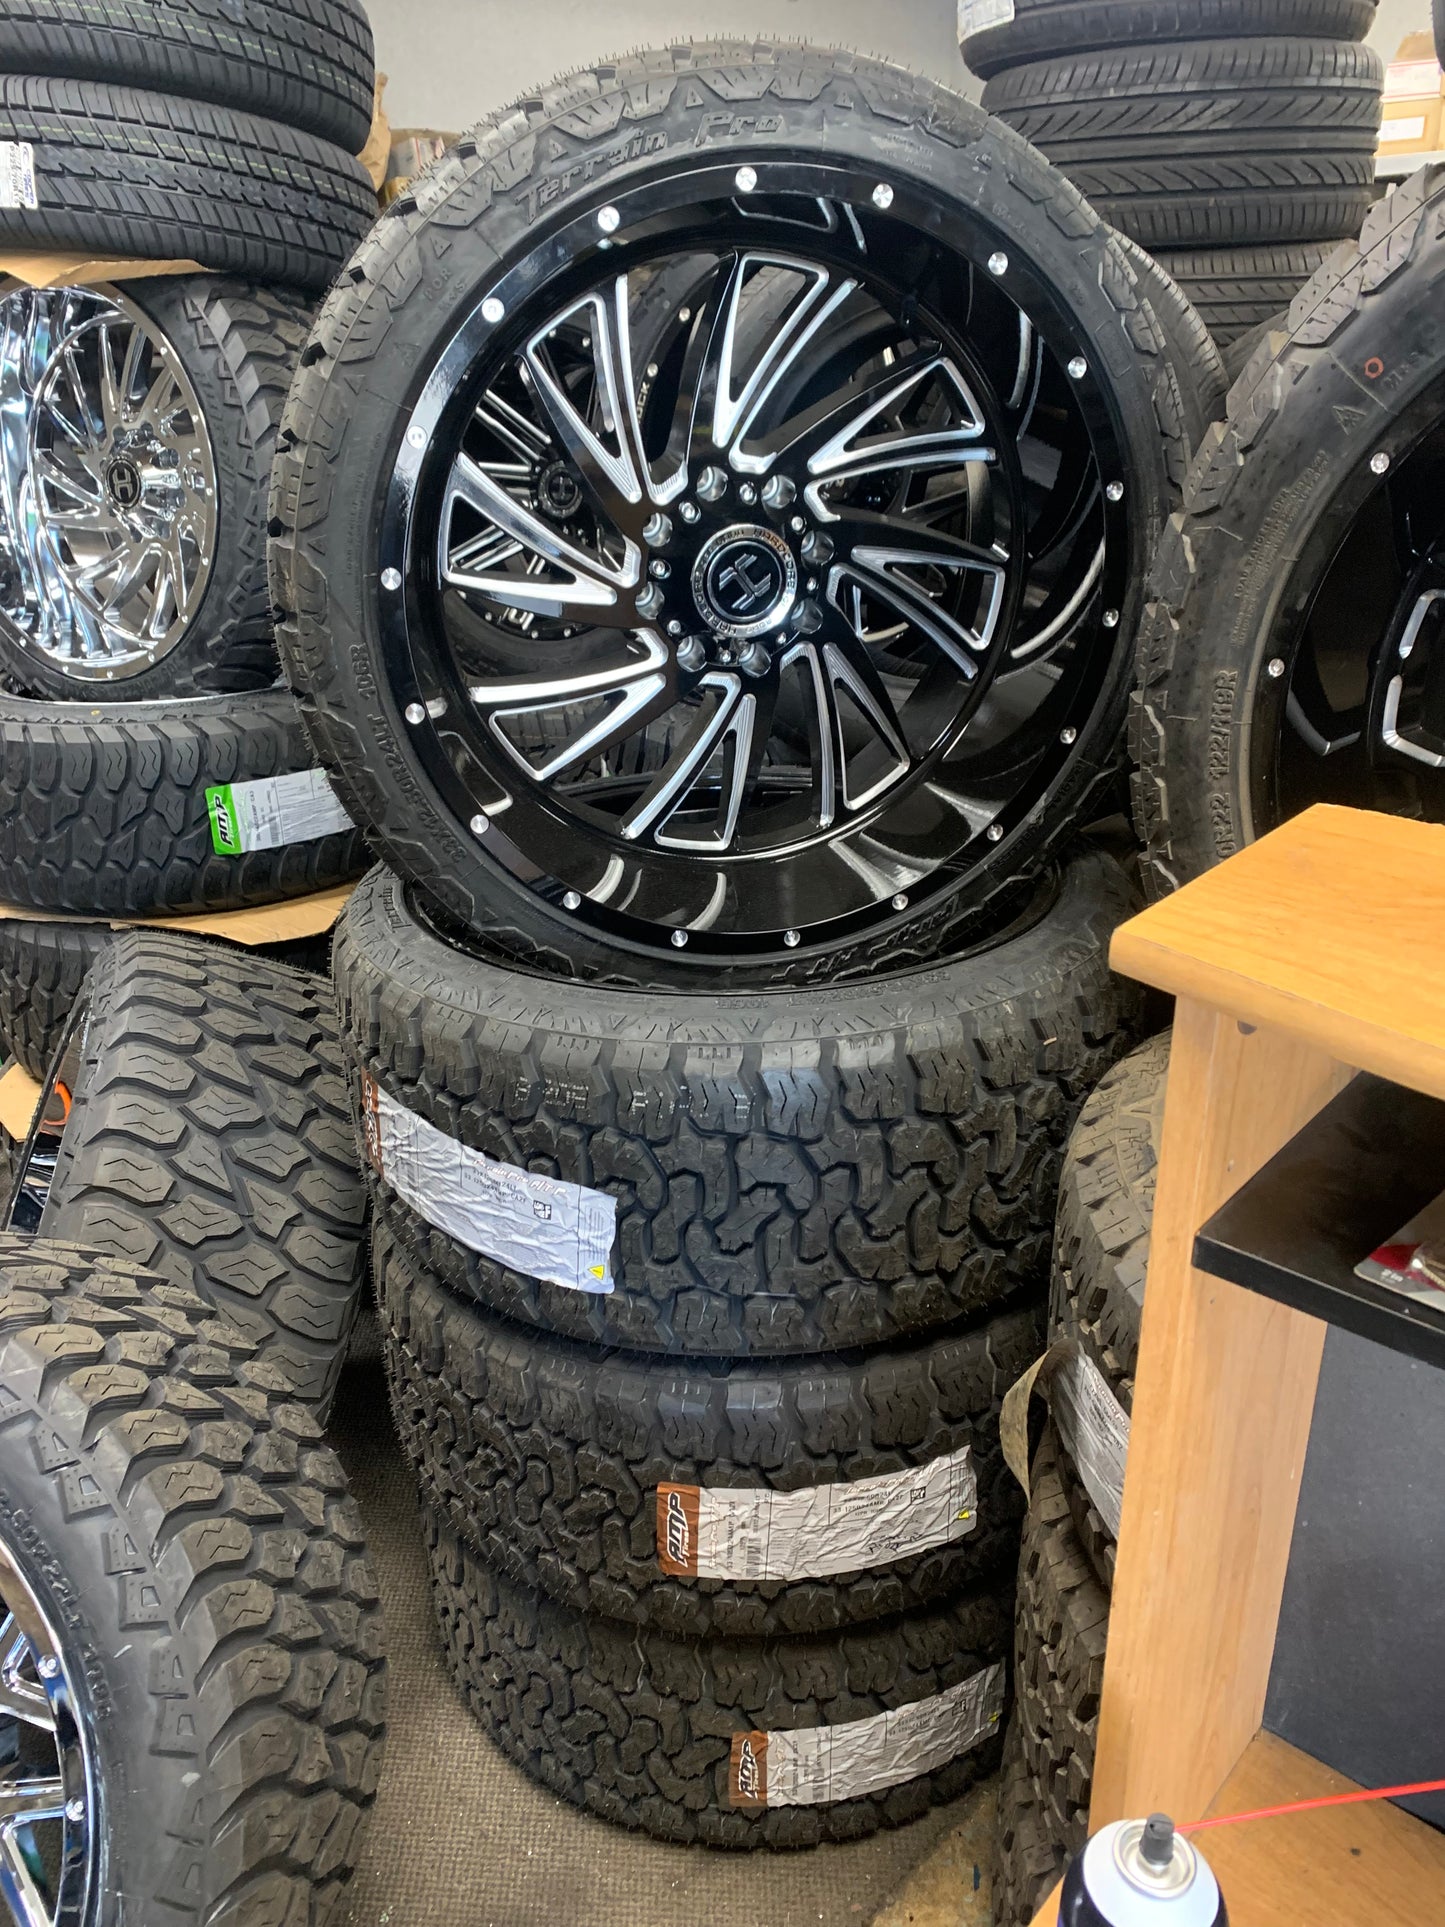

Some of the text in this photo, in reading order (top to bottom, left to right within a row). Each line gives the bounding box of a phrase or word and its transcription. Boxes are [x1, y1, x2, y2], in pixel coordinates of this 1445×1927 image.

[514, 109, 786, 226] Terrain Pro
[666, 1491, 689, 1569] AMP
